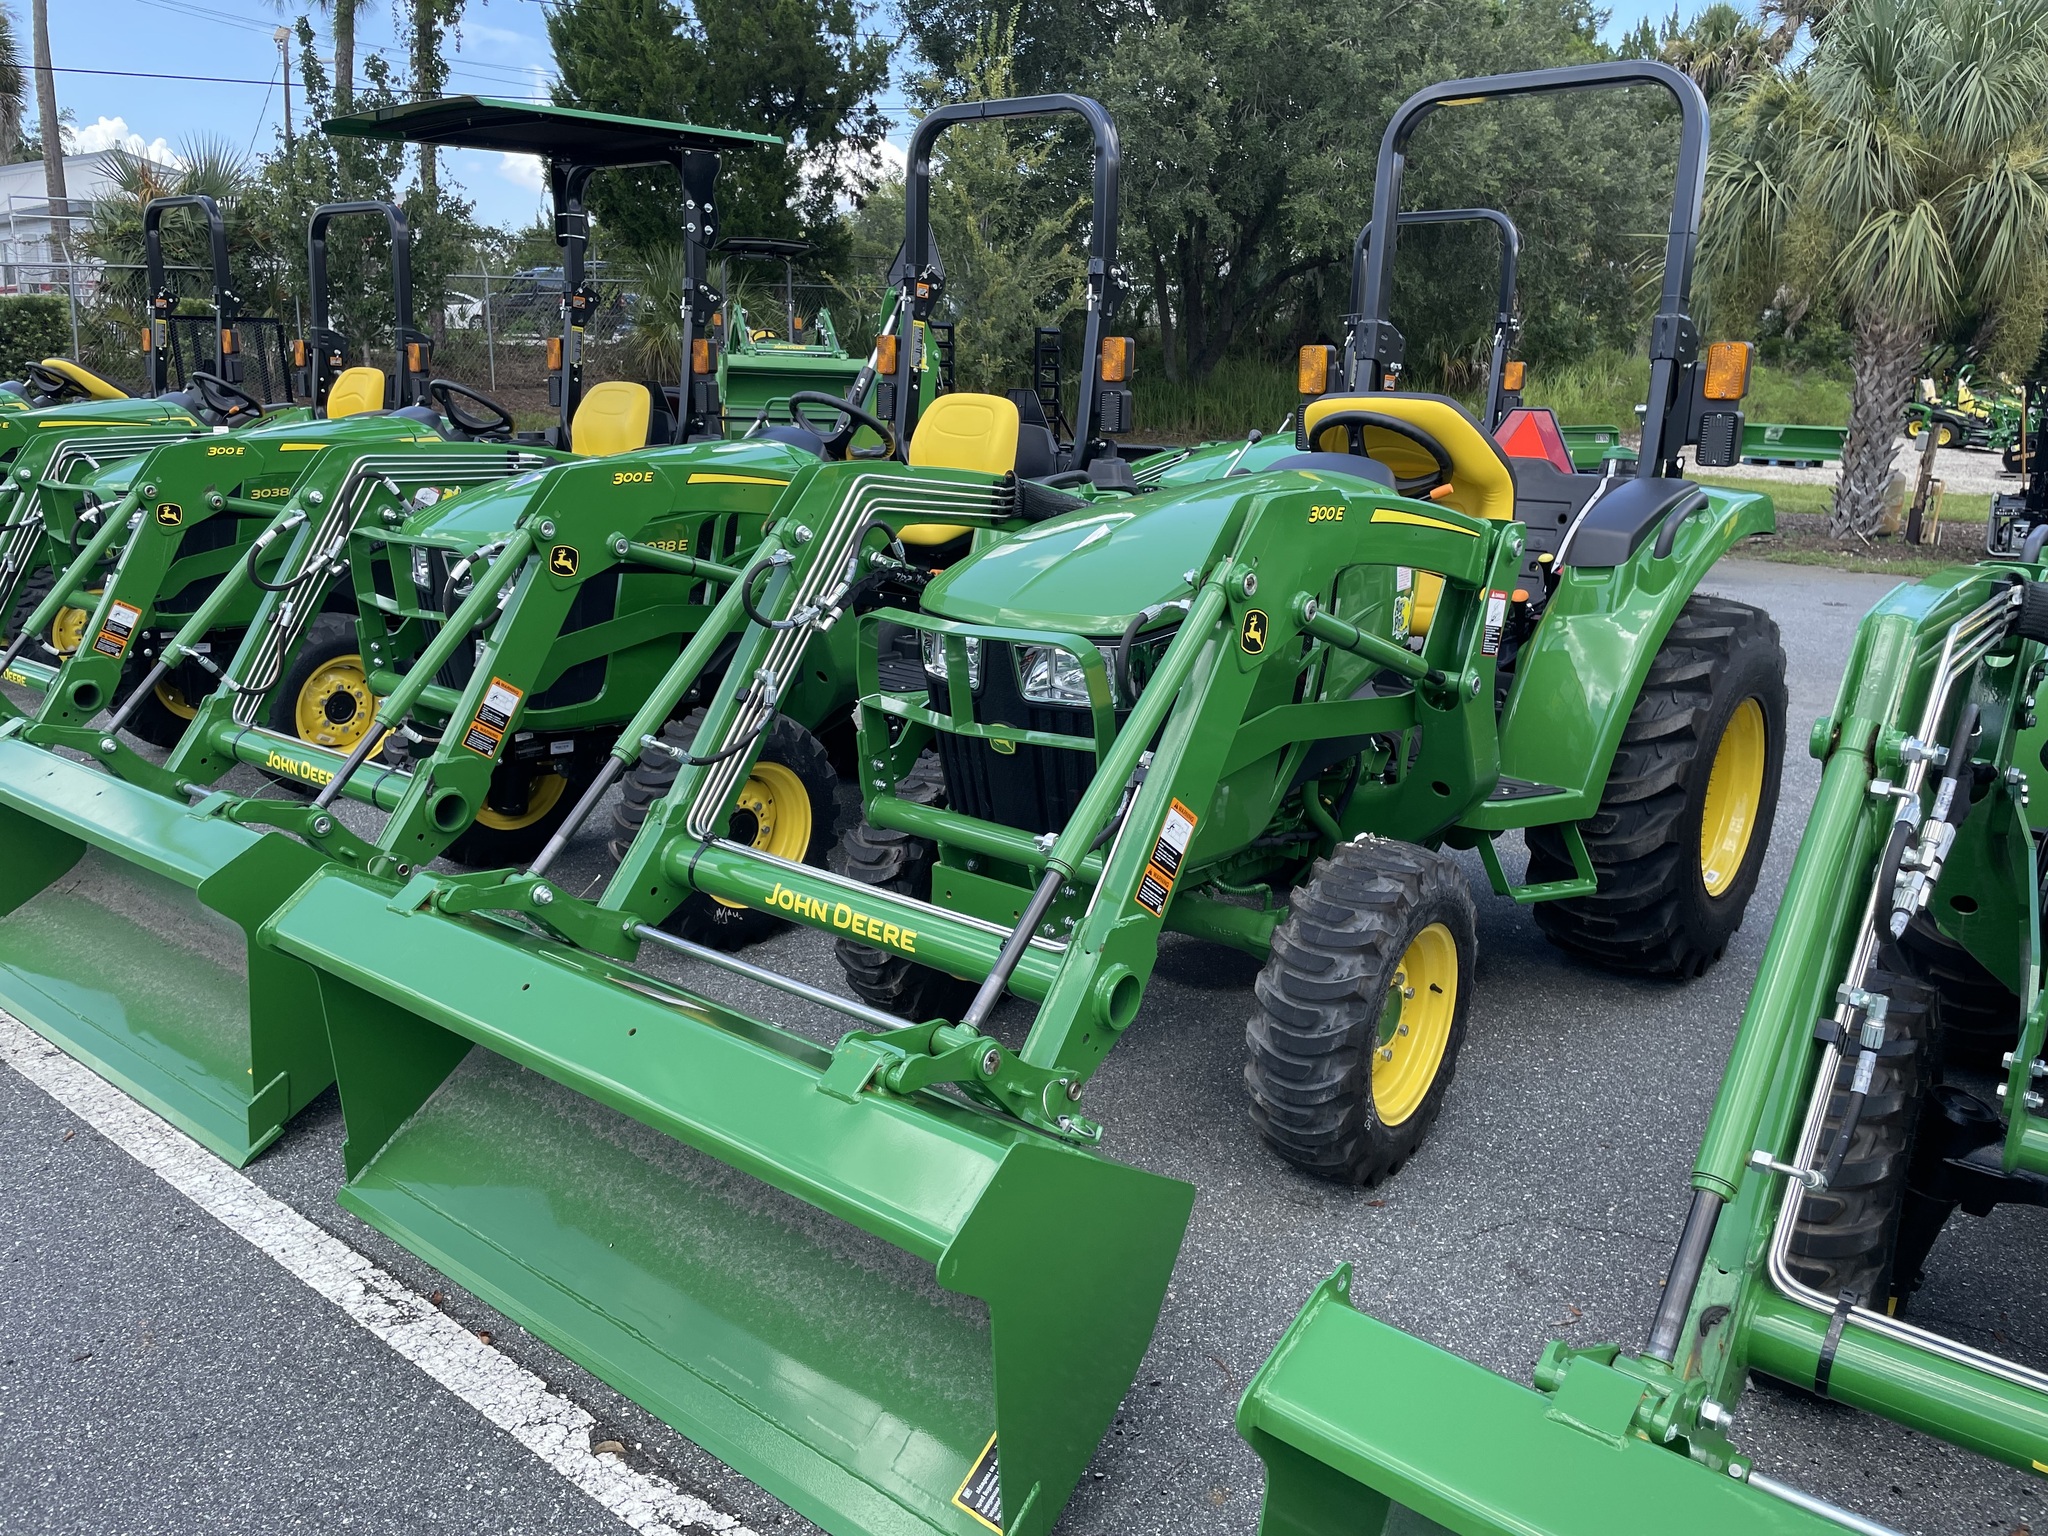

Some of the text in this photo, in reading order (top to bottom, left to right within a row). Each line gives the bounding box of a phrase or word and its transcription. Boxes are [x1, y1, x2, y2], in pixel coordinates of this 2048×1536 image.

[207, 447, 246, 456] 300 E
[612, 471, 654, 485] 300 E
[250, 487, 290, 500] 3038
[1308, 505, 1346, 523] 300 E
[639, 539, 689, 552] 038 E
[265, 750, 335, 786] JOHN DEER
[765, 882, 828, 923] JOHN
[833, 902, 918, 953] DEERE
